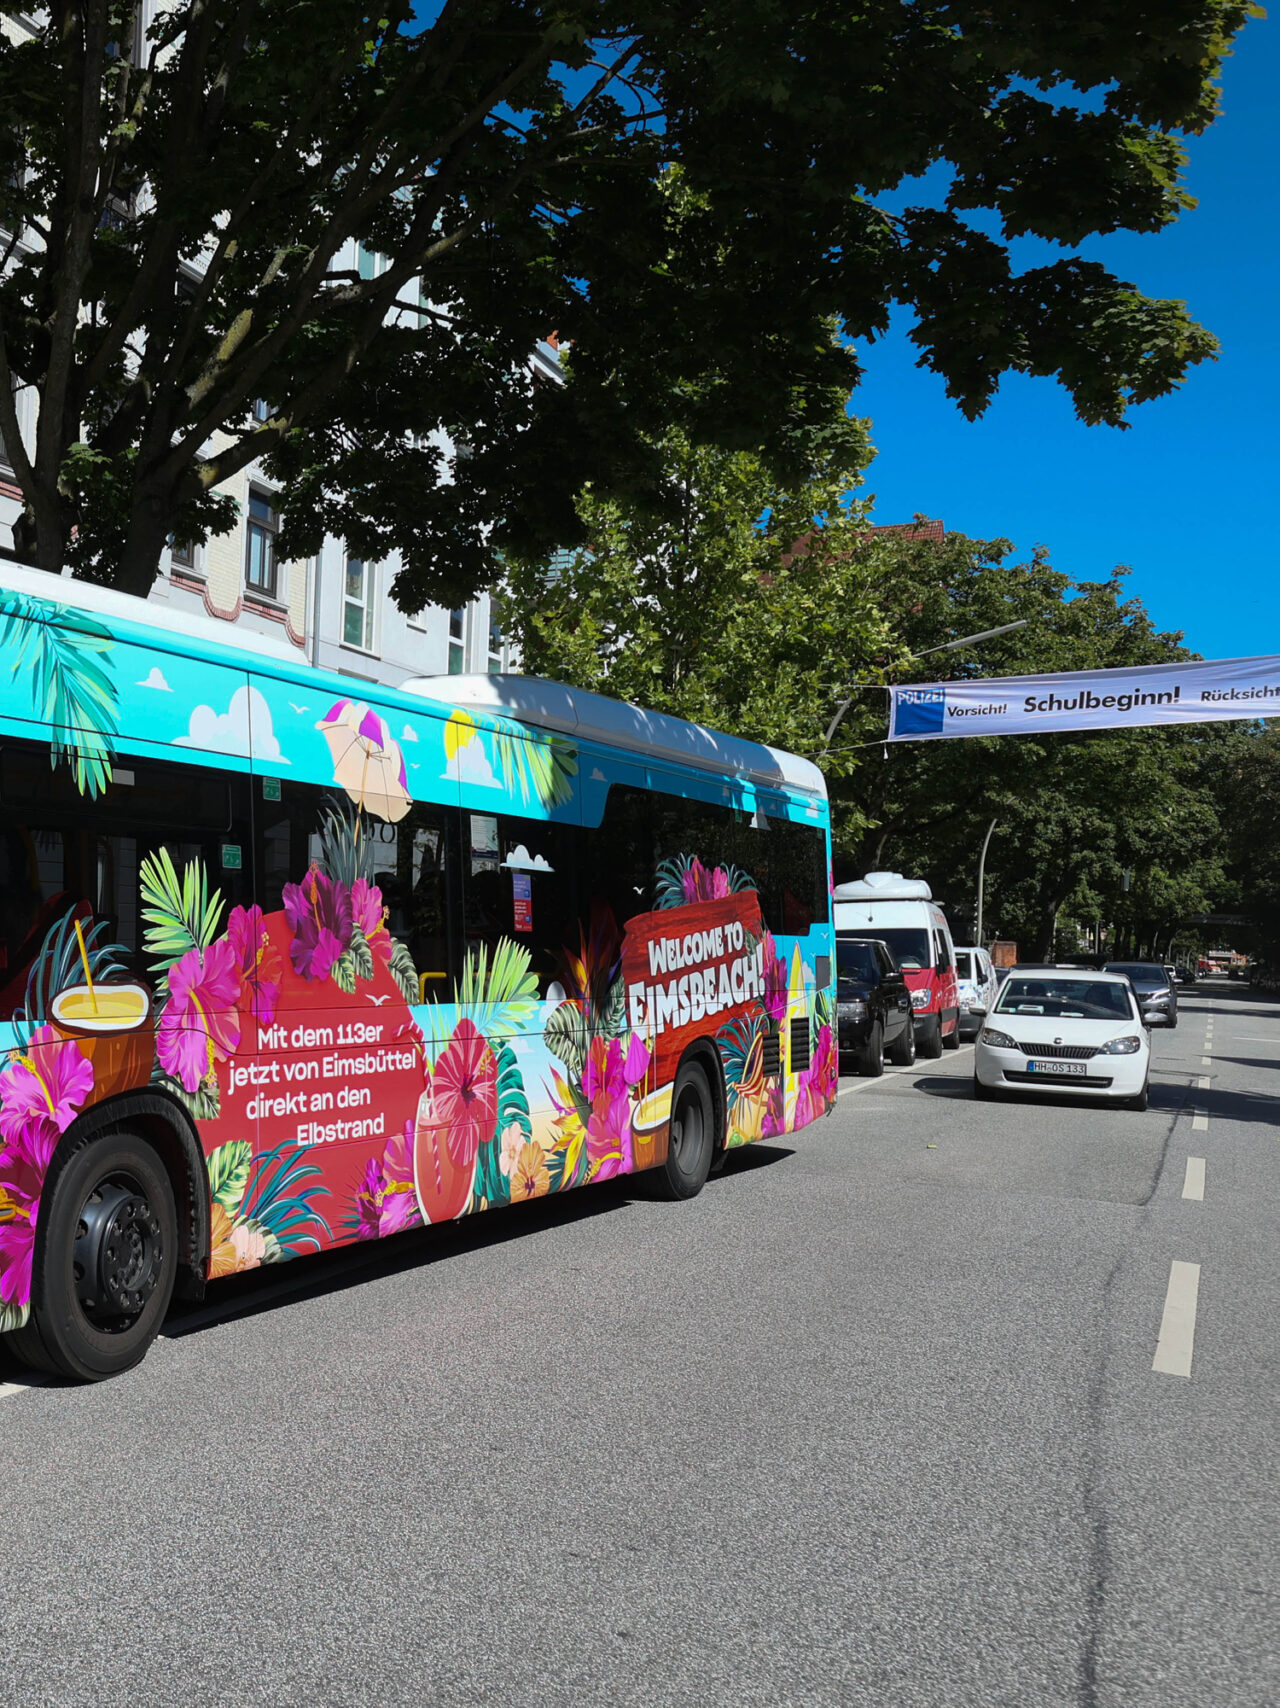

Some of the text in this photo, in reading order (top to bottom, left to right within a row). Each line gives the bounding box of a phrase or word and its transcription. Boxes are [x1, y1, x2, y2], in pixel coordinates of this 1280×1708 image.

[897, 690, 945, 705] POLIZEI
[947, 703, 1008, 717] Vorsicht!
[1023, 686, 1181, 713] Schulbeginn!
[647, 921, 743, 977] WELCOME TO
[628, 942, 766, 1041] EIMSBEACH!
[257, 1022, 384, 1050] Mit dem 113er
[227, 1048, 416, 1095] jetzt von Eimsbüttel
[1034, 1062, 1046, 1070] HH
[1066, 1065, 1084, 1074] 133
[246, 1086, 371, 1120] direkt an den
[297, 1113, 384, 1146] Elbstrand
